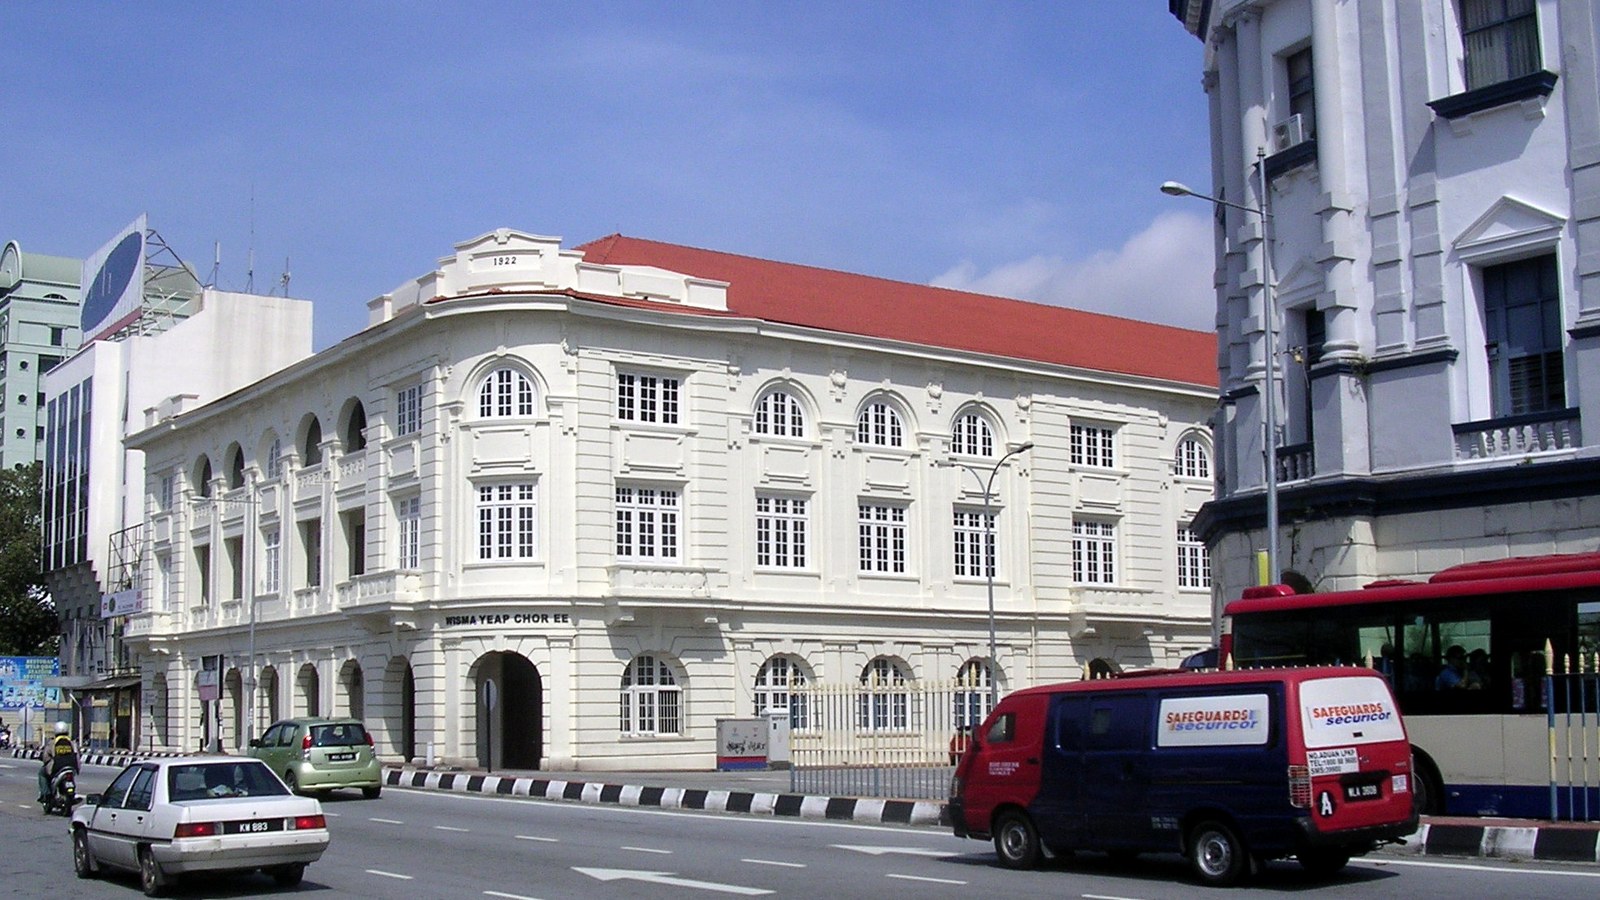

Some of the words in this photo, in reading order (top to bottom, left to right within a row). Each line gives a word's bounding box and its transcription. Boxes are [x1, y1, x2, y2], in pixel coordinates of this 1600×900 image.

[493, 256, 517, 266] 1922
[446, 615, 477, 626] WISMA
[479, 614, 510, 624] YEAP
[514, 613, 549, 624] CHOR
[553, 613, 569, 623] EE
[1166, 709, 1248, 724] SAFEGUARDS
[1313, 703, 1383, 718] SAFEGUARDS
[1175, 720, 1258, 731] securicor
[1326, 711, 1391, 726] securicor
[1321, 792, 1333, 815] A
[239, 823, 251, 832] KW
[252, 822, 268, 832] 883
